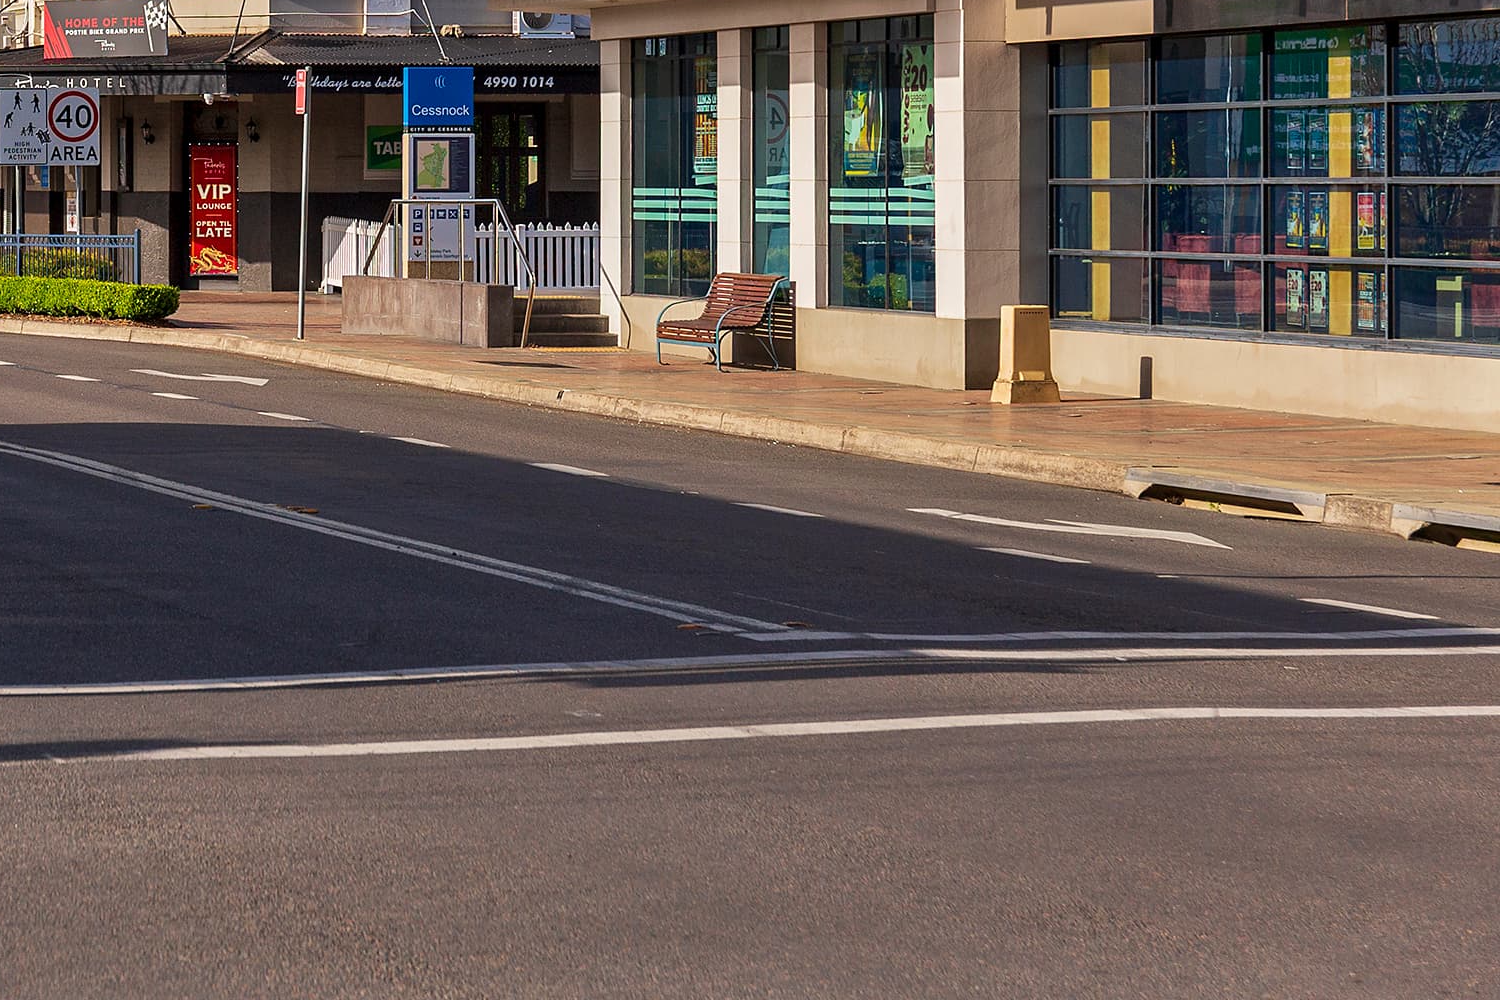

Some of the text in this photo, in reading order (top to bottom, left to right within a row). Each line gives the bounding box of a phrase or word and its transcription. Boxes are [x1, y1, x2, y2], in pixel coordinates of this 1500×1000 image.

[65, 16, 145, 28] HOME OF THE
[65, 28, 87, 36] POSTIE
[66, 78, 126, 88] HOTEL
[374, 76, 404, 88] bette
[484, 76, 517, 88] 4990
[522, 76, 555, 88] 1014
[911, 64, 928, 92] 20
[411, 104, 470, 116] Cessnock
[55, 104, 92, 129] 40
[50, 145, 98, 161] AREA
[373, 141, 401, 155] TAB
[196, 183, 232, 200] VIP
[196, 227, 232, 238] LATE
